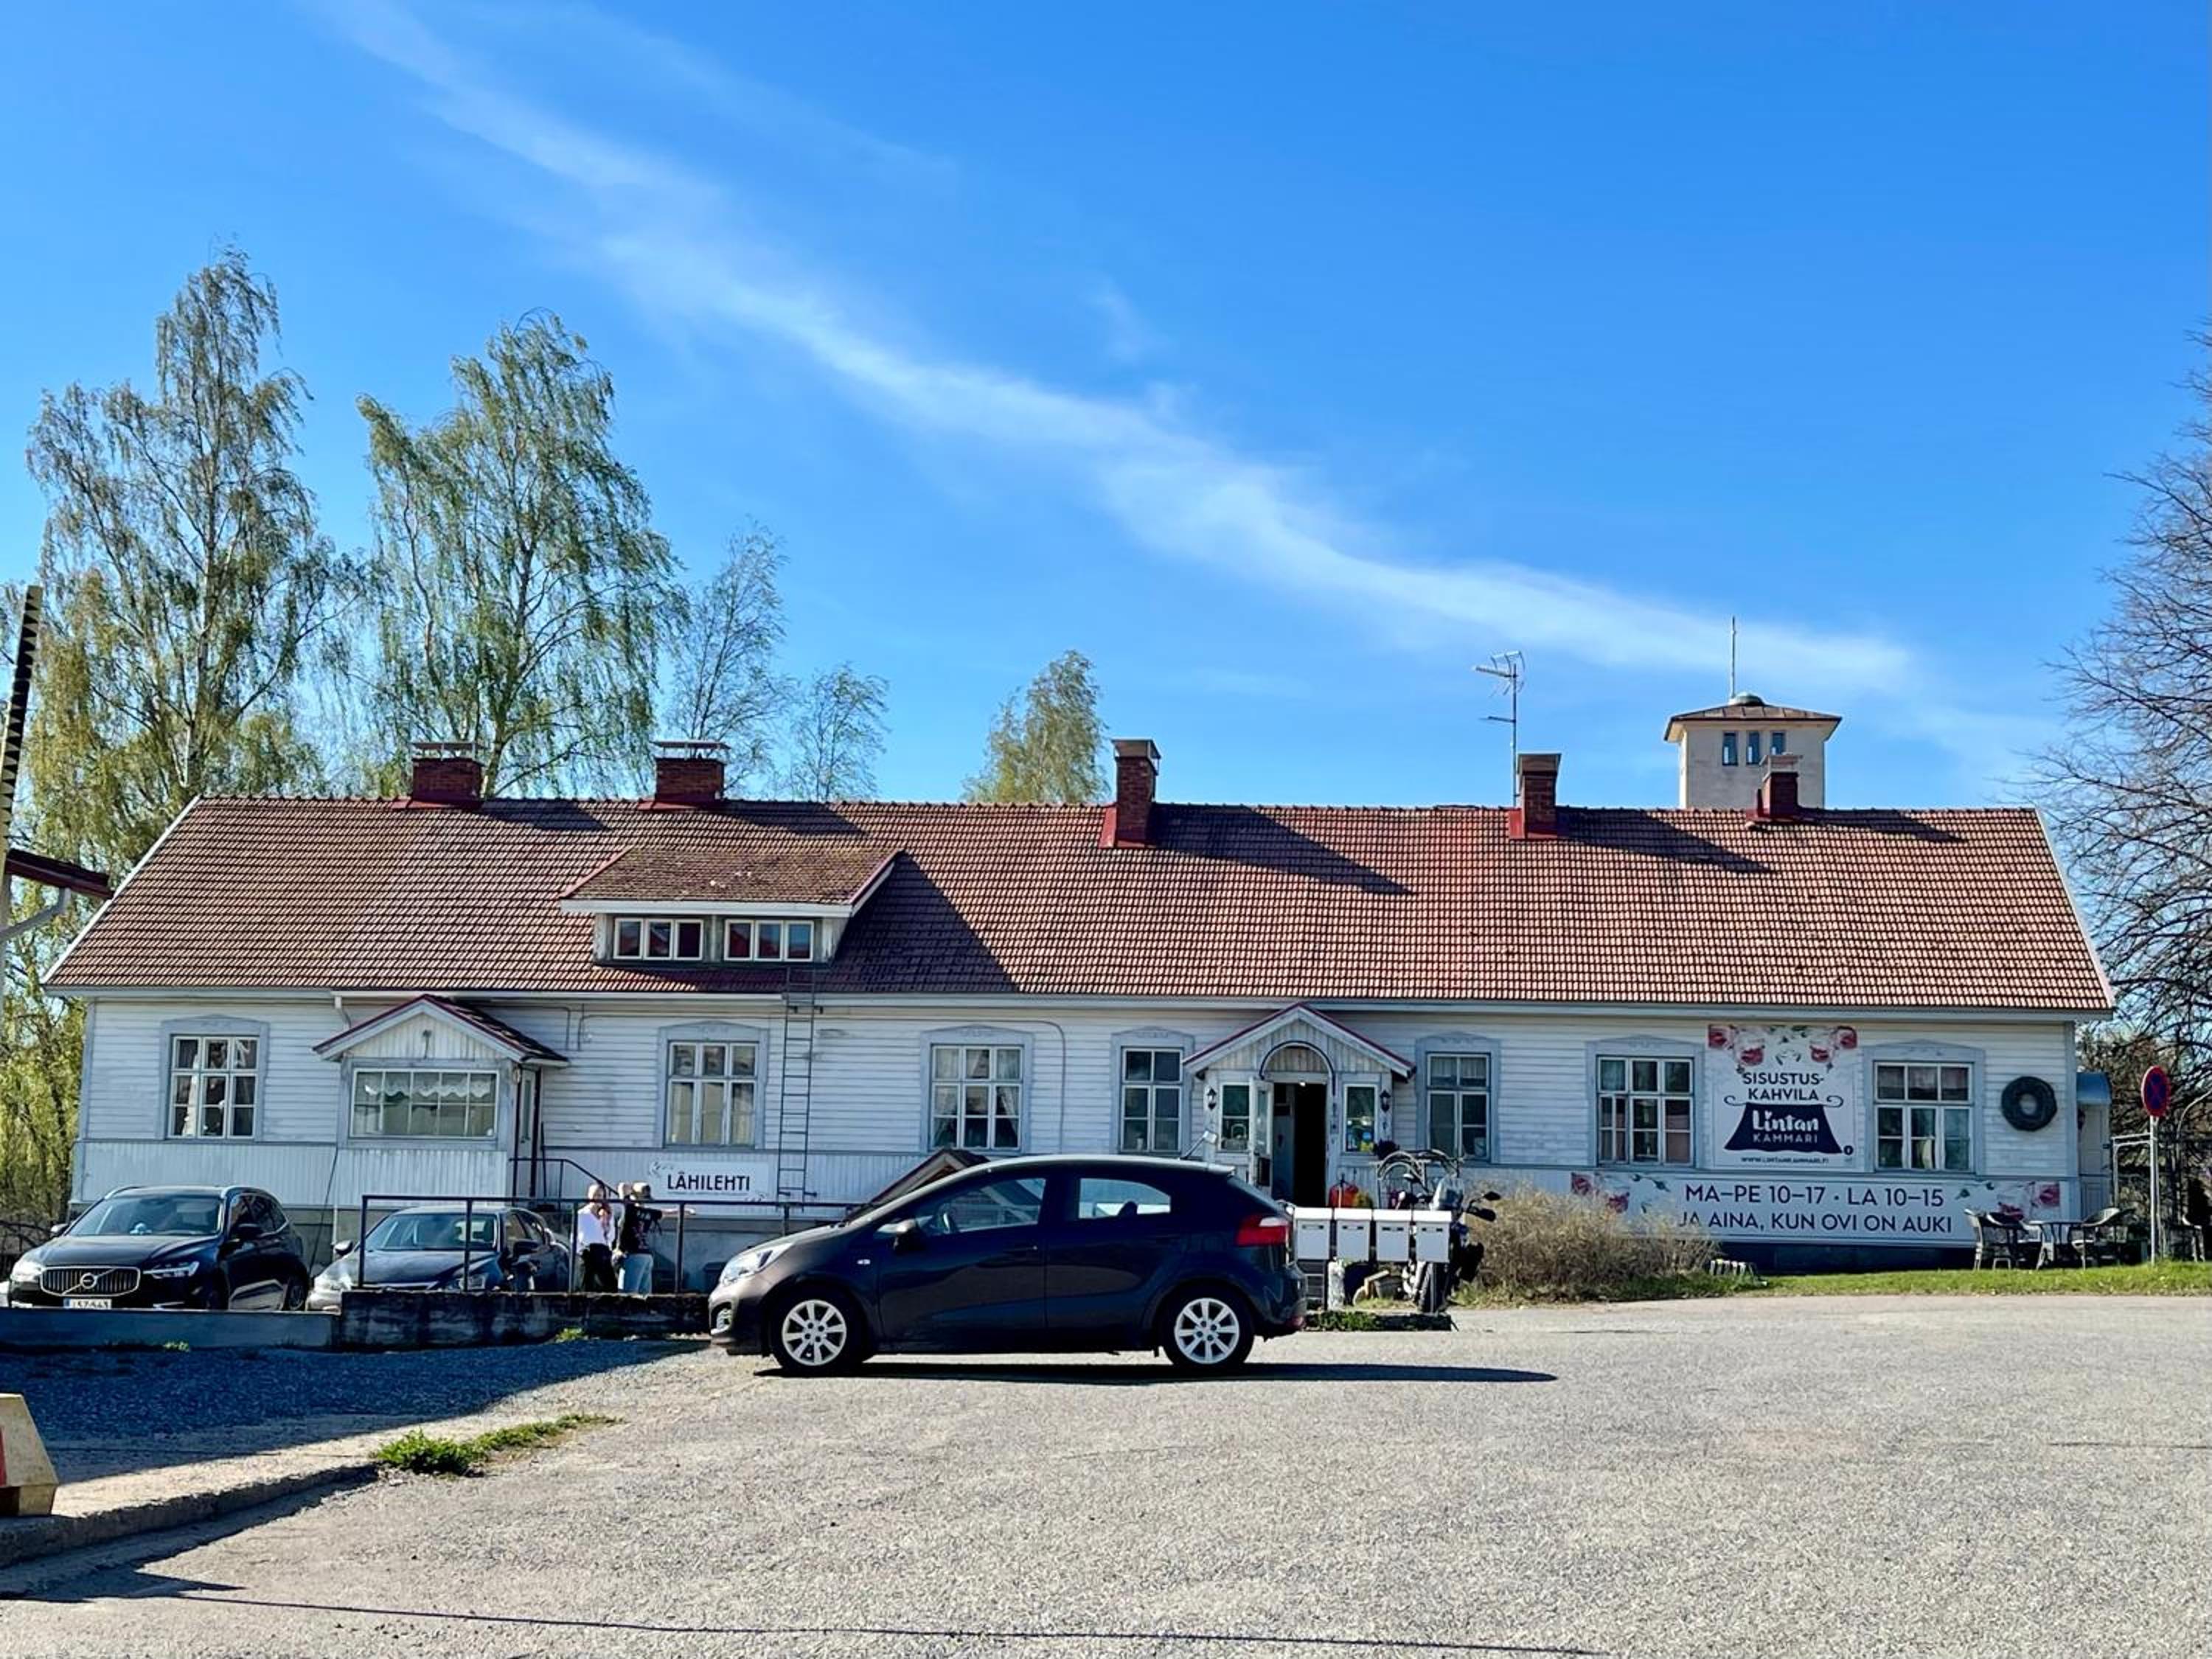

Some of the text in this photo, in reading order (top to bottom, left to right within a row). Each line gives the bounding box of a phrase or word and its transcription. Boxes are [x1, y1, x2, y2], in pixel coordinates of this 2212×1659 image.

[1742, 1072, 1825, 1085] SISUSTUS-
[1748, 1088, 1819, 1101] KAHVILA
[1753, 1110, 1819, 1132] Lintan
[1753, 1134, 1818, 1144] KAMMARI
[667, 1171, 750, 1191] LÄHILEHTI
[1848, 1187, 1878, 1206] LA
[1708, 1211, 1764, 1231] AINA,
[1771, 1213, 1815, 1229] KUN
[1821, 1214, 1857, 1231] OVI
[1864, 1214, 1896, 1231] ON
[1902, 1216, 1952, 1233] AUKI
